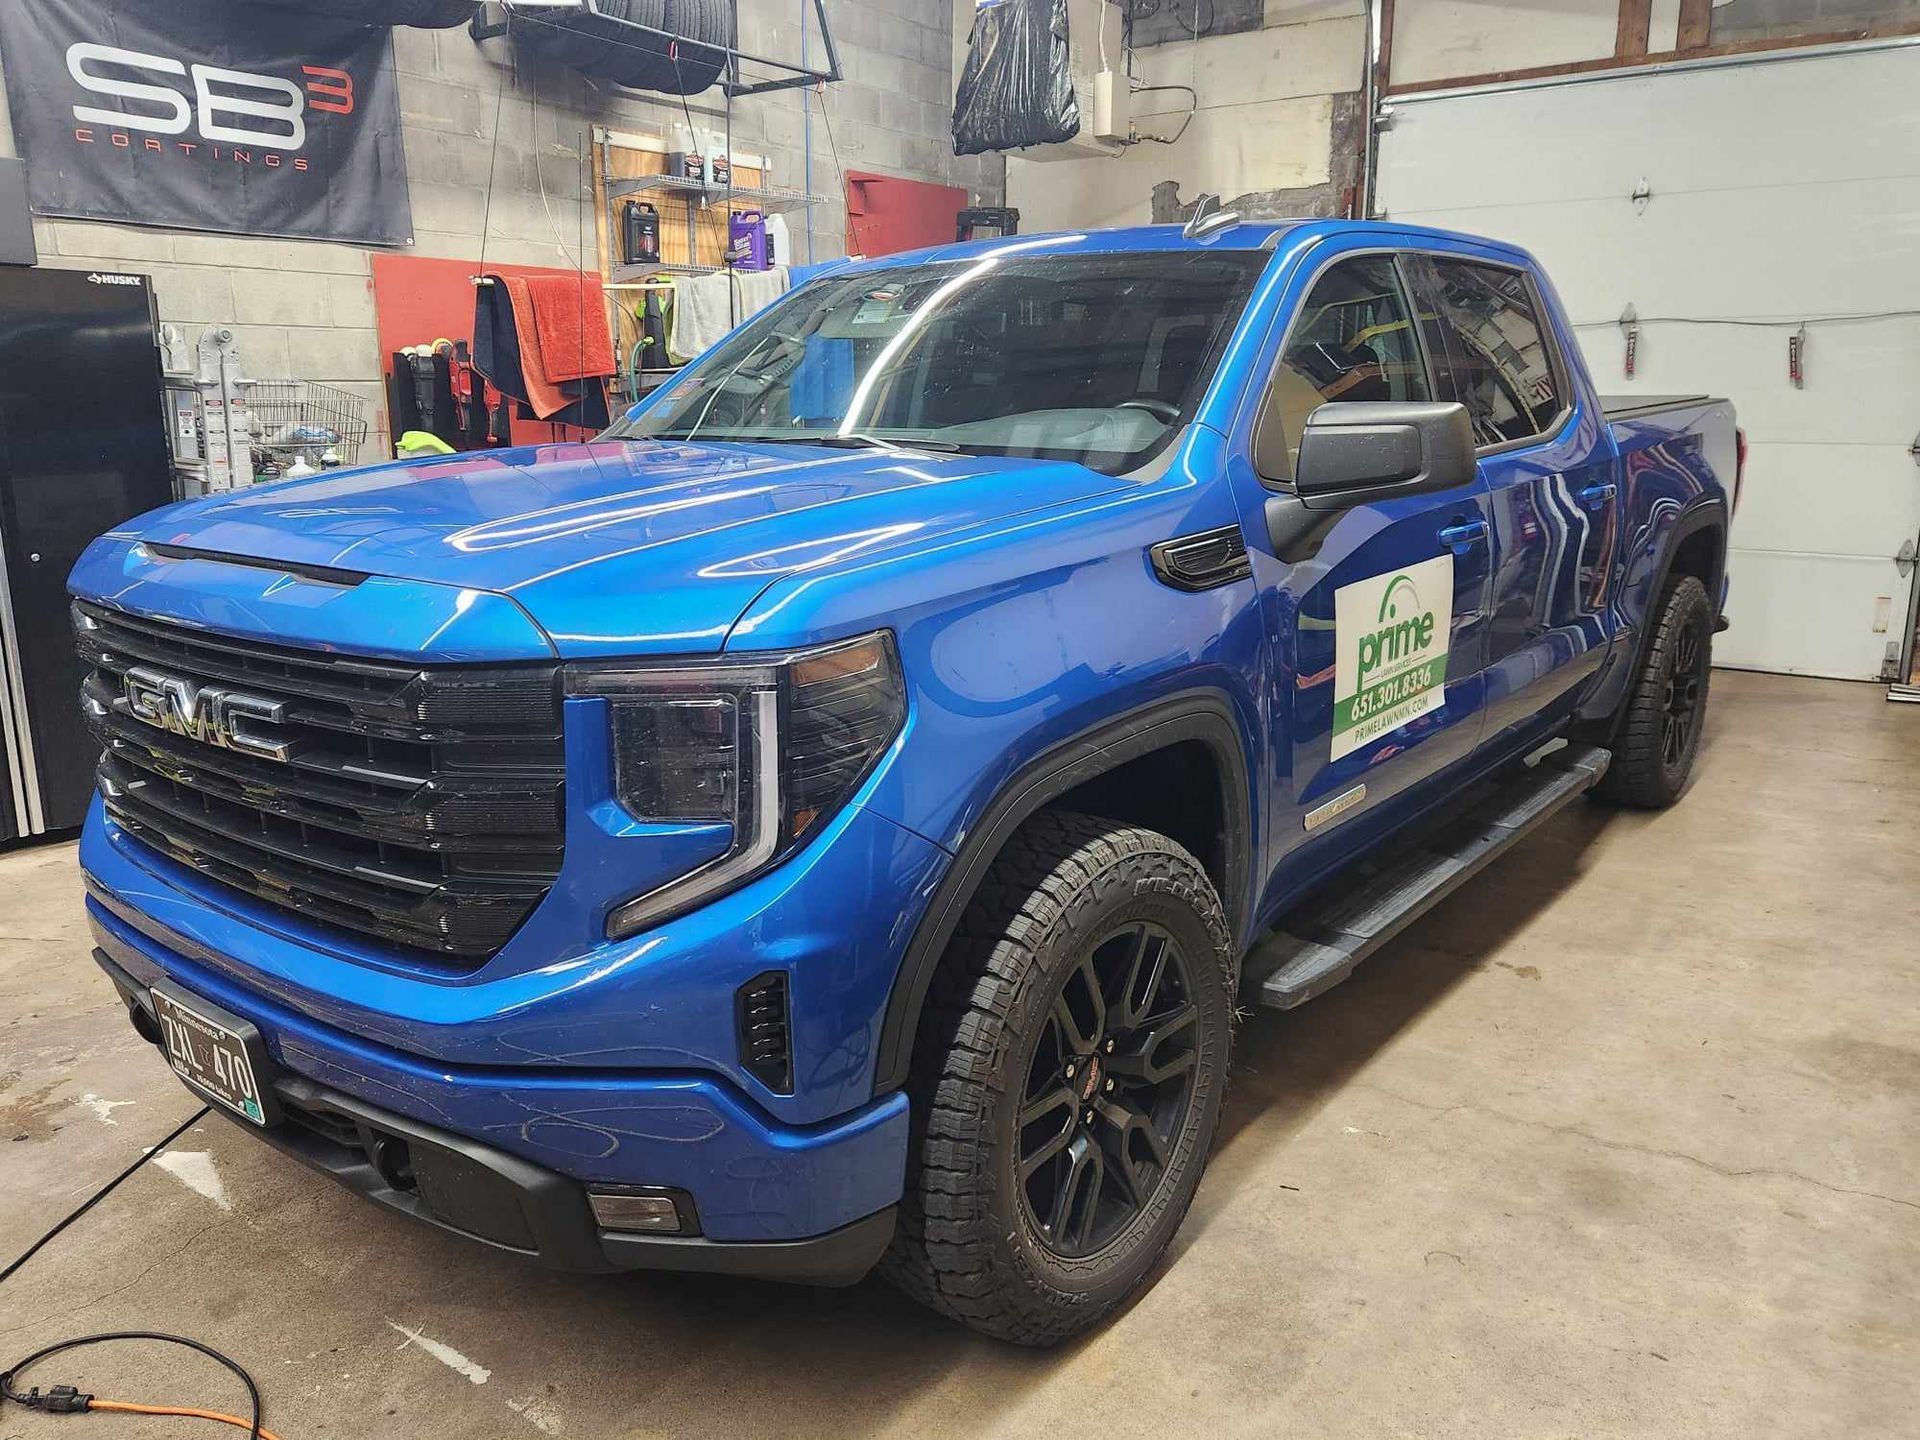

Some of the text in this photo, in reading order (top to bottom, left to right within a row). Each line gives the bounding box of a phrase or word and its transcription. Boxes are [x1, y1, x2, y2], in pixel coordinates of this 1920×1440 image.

[75, 128, 308, 171] COATINGS
[102, 274, 141, 286] HUSKY
[1357, 603, 1434, 696] prime
[124, 666, 294, 763] GMC
[1351, 665, 1432, 721] 651.301.8336
[1354, 696, 1429, 743] PRIMELAWNMN.COM
[172, 1004, 219, 1040] Minnesota
[161, 1013, 252, 1100] ZXL 470
